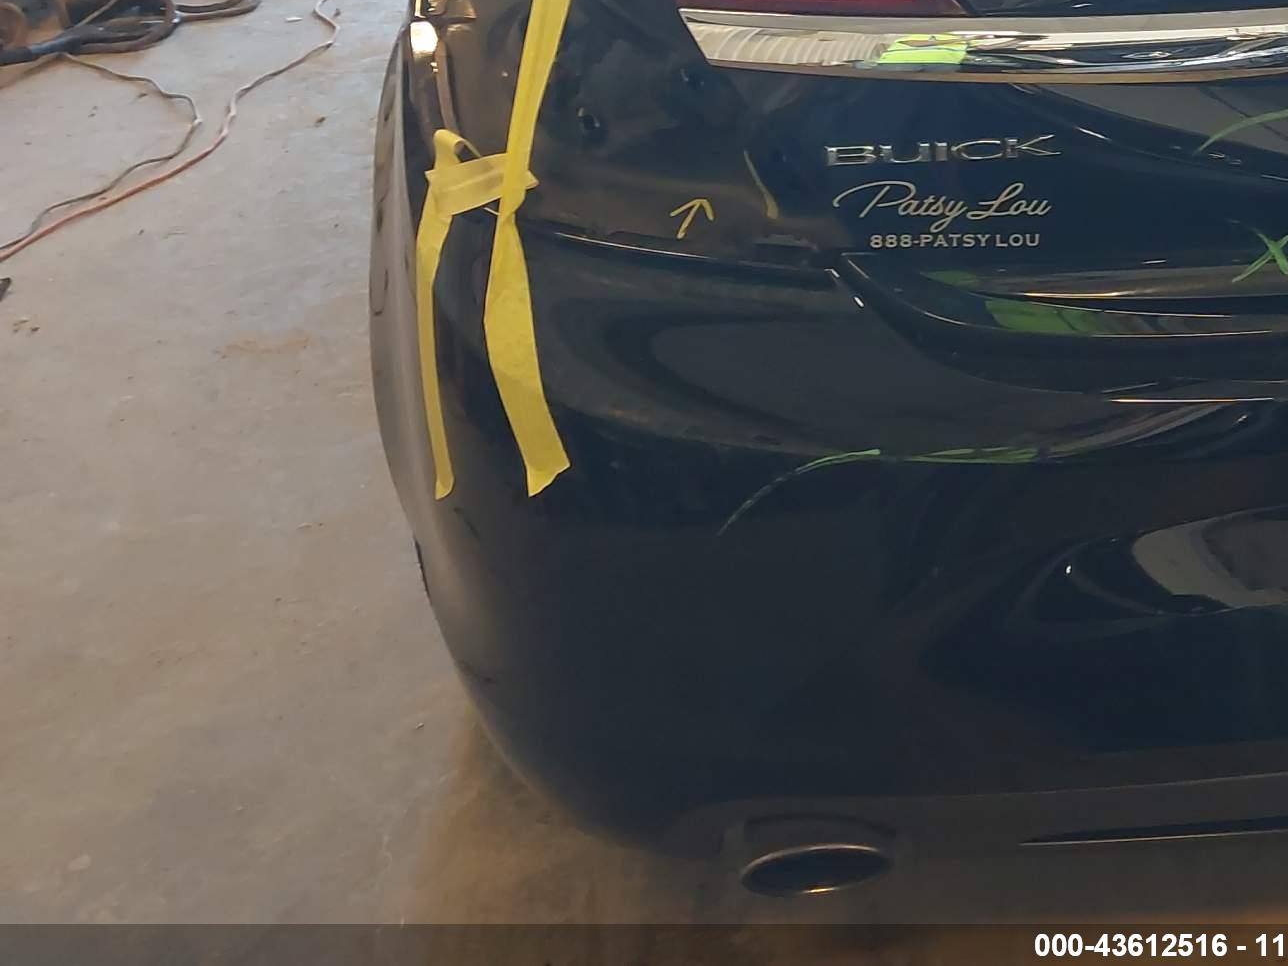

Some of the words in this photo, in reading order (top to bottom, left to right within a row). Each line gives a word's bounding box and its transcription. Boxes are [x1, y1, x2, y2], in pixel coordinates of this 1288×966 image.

[825, 134, 1061, 165] BUICK
[833, 180, 966, 233] Patsy
[966, 182, 1051, 220] Lou
[870, 234, 990, 248] 888-PATSY
[995, 233, 1040, 247] LOU
